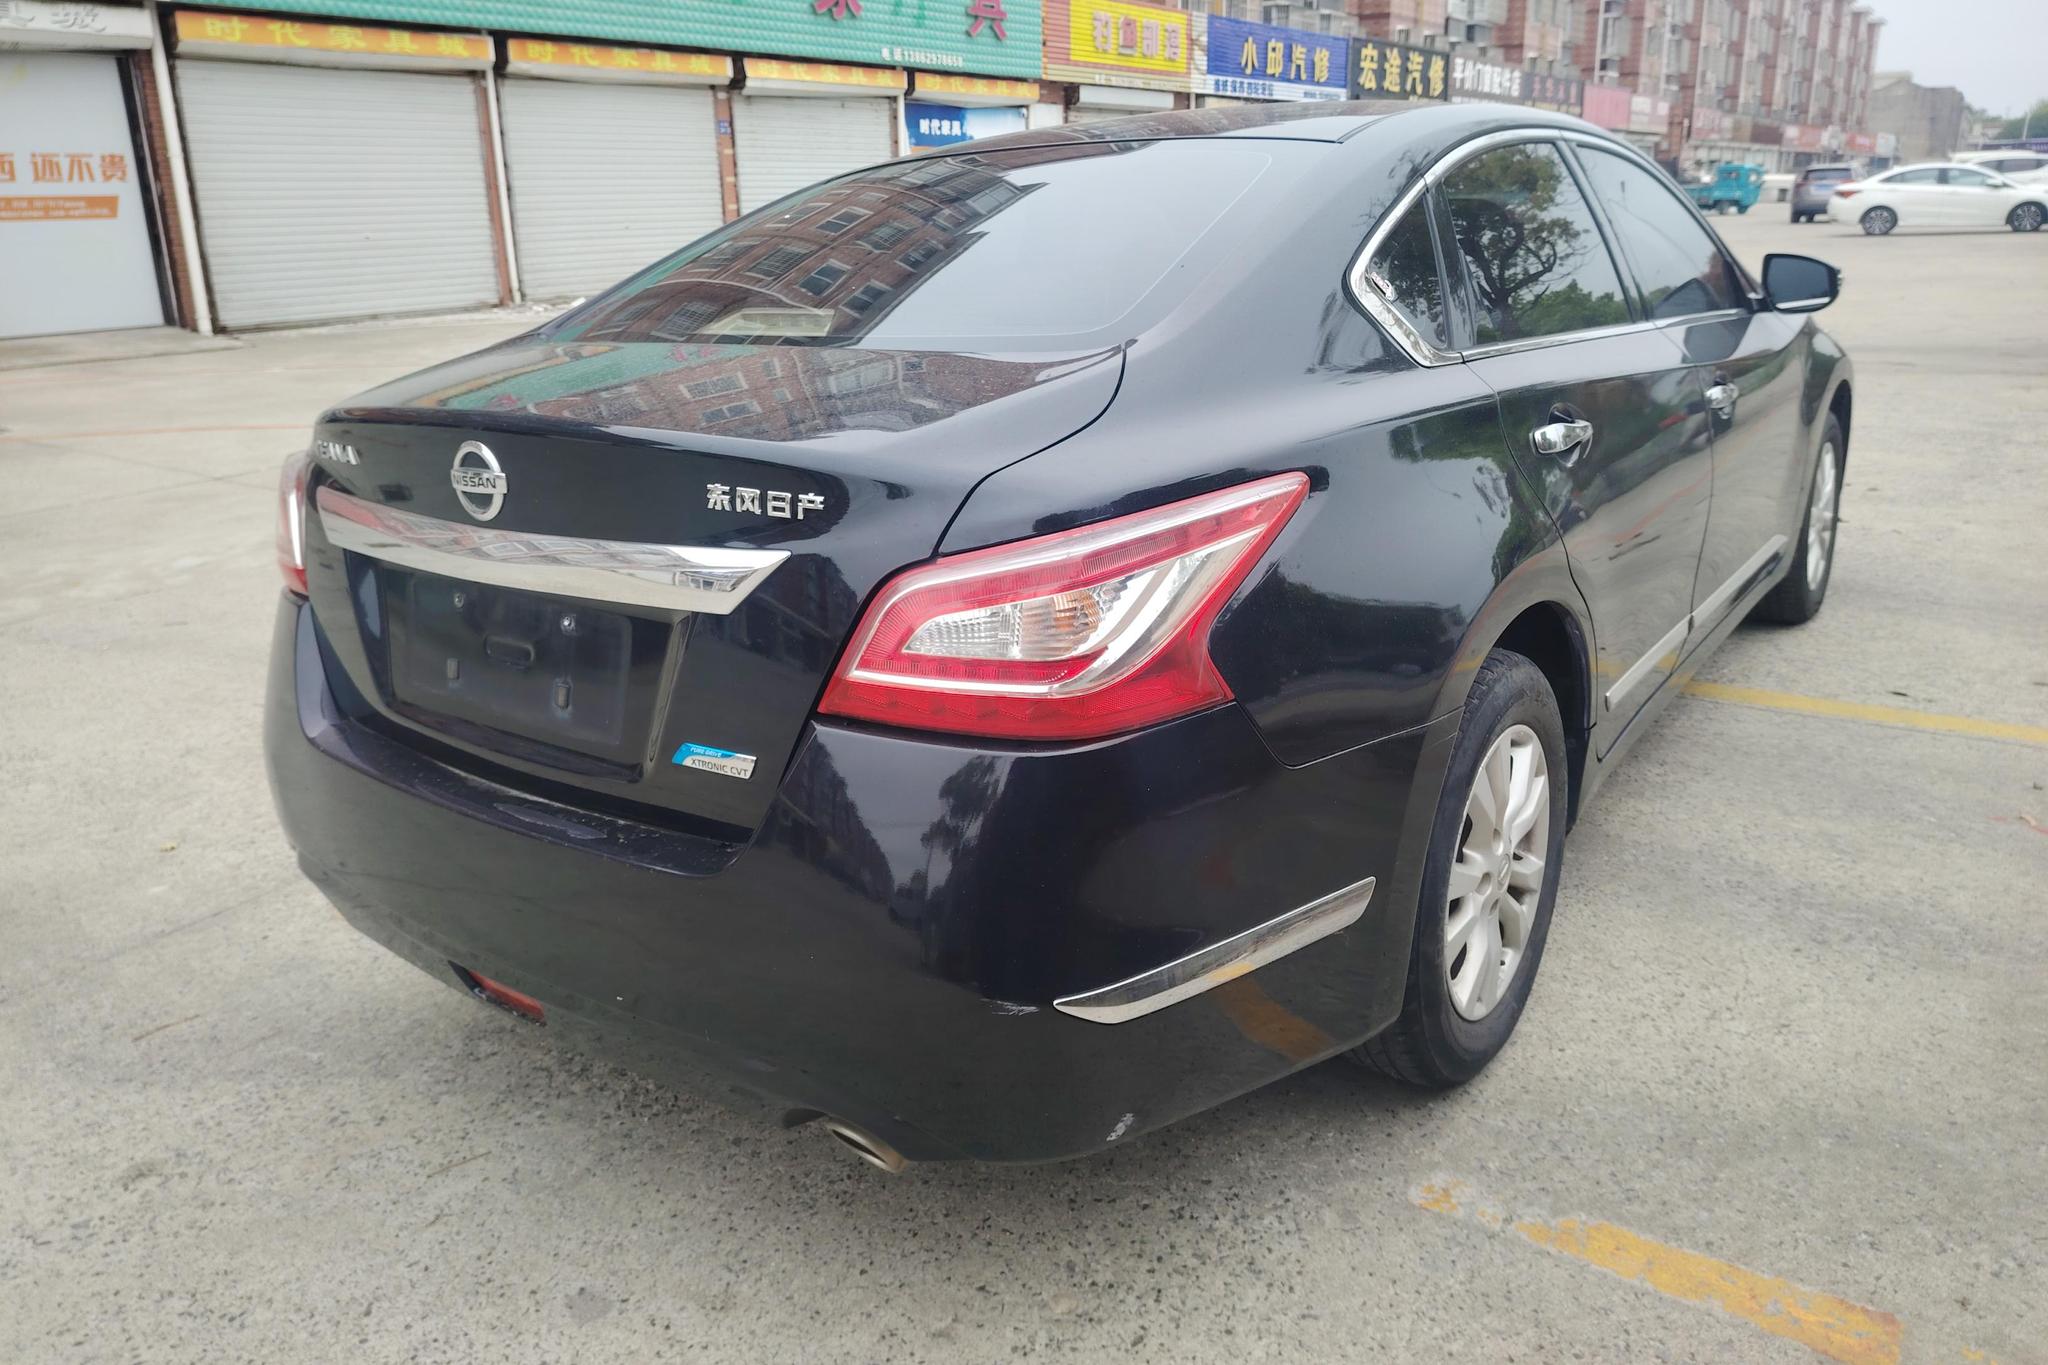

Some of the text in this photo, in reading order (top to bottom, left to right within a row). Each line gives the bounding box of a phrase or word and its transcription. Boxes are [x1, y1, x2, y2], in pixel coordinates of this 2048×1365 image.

[204, 16, 471, 58] 时代家具城
[526, 42, 713, 74] 时代家具城
[1356, 42, 1446, 98] 宏途汽修
[452, 471, 497, 490] NISSAN
[706, 482, 825, 520] 东风日产
[691, 758, 749, 777] XTRONIC CVT
